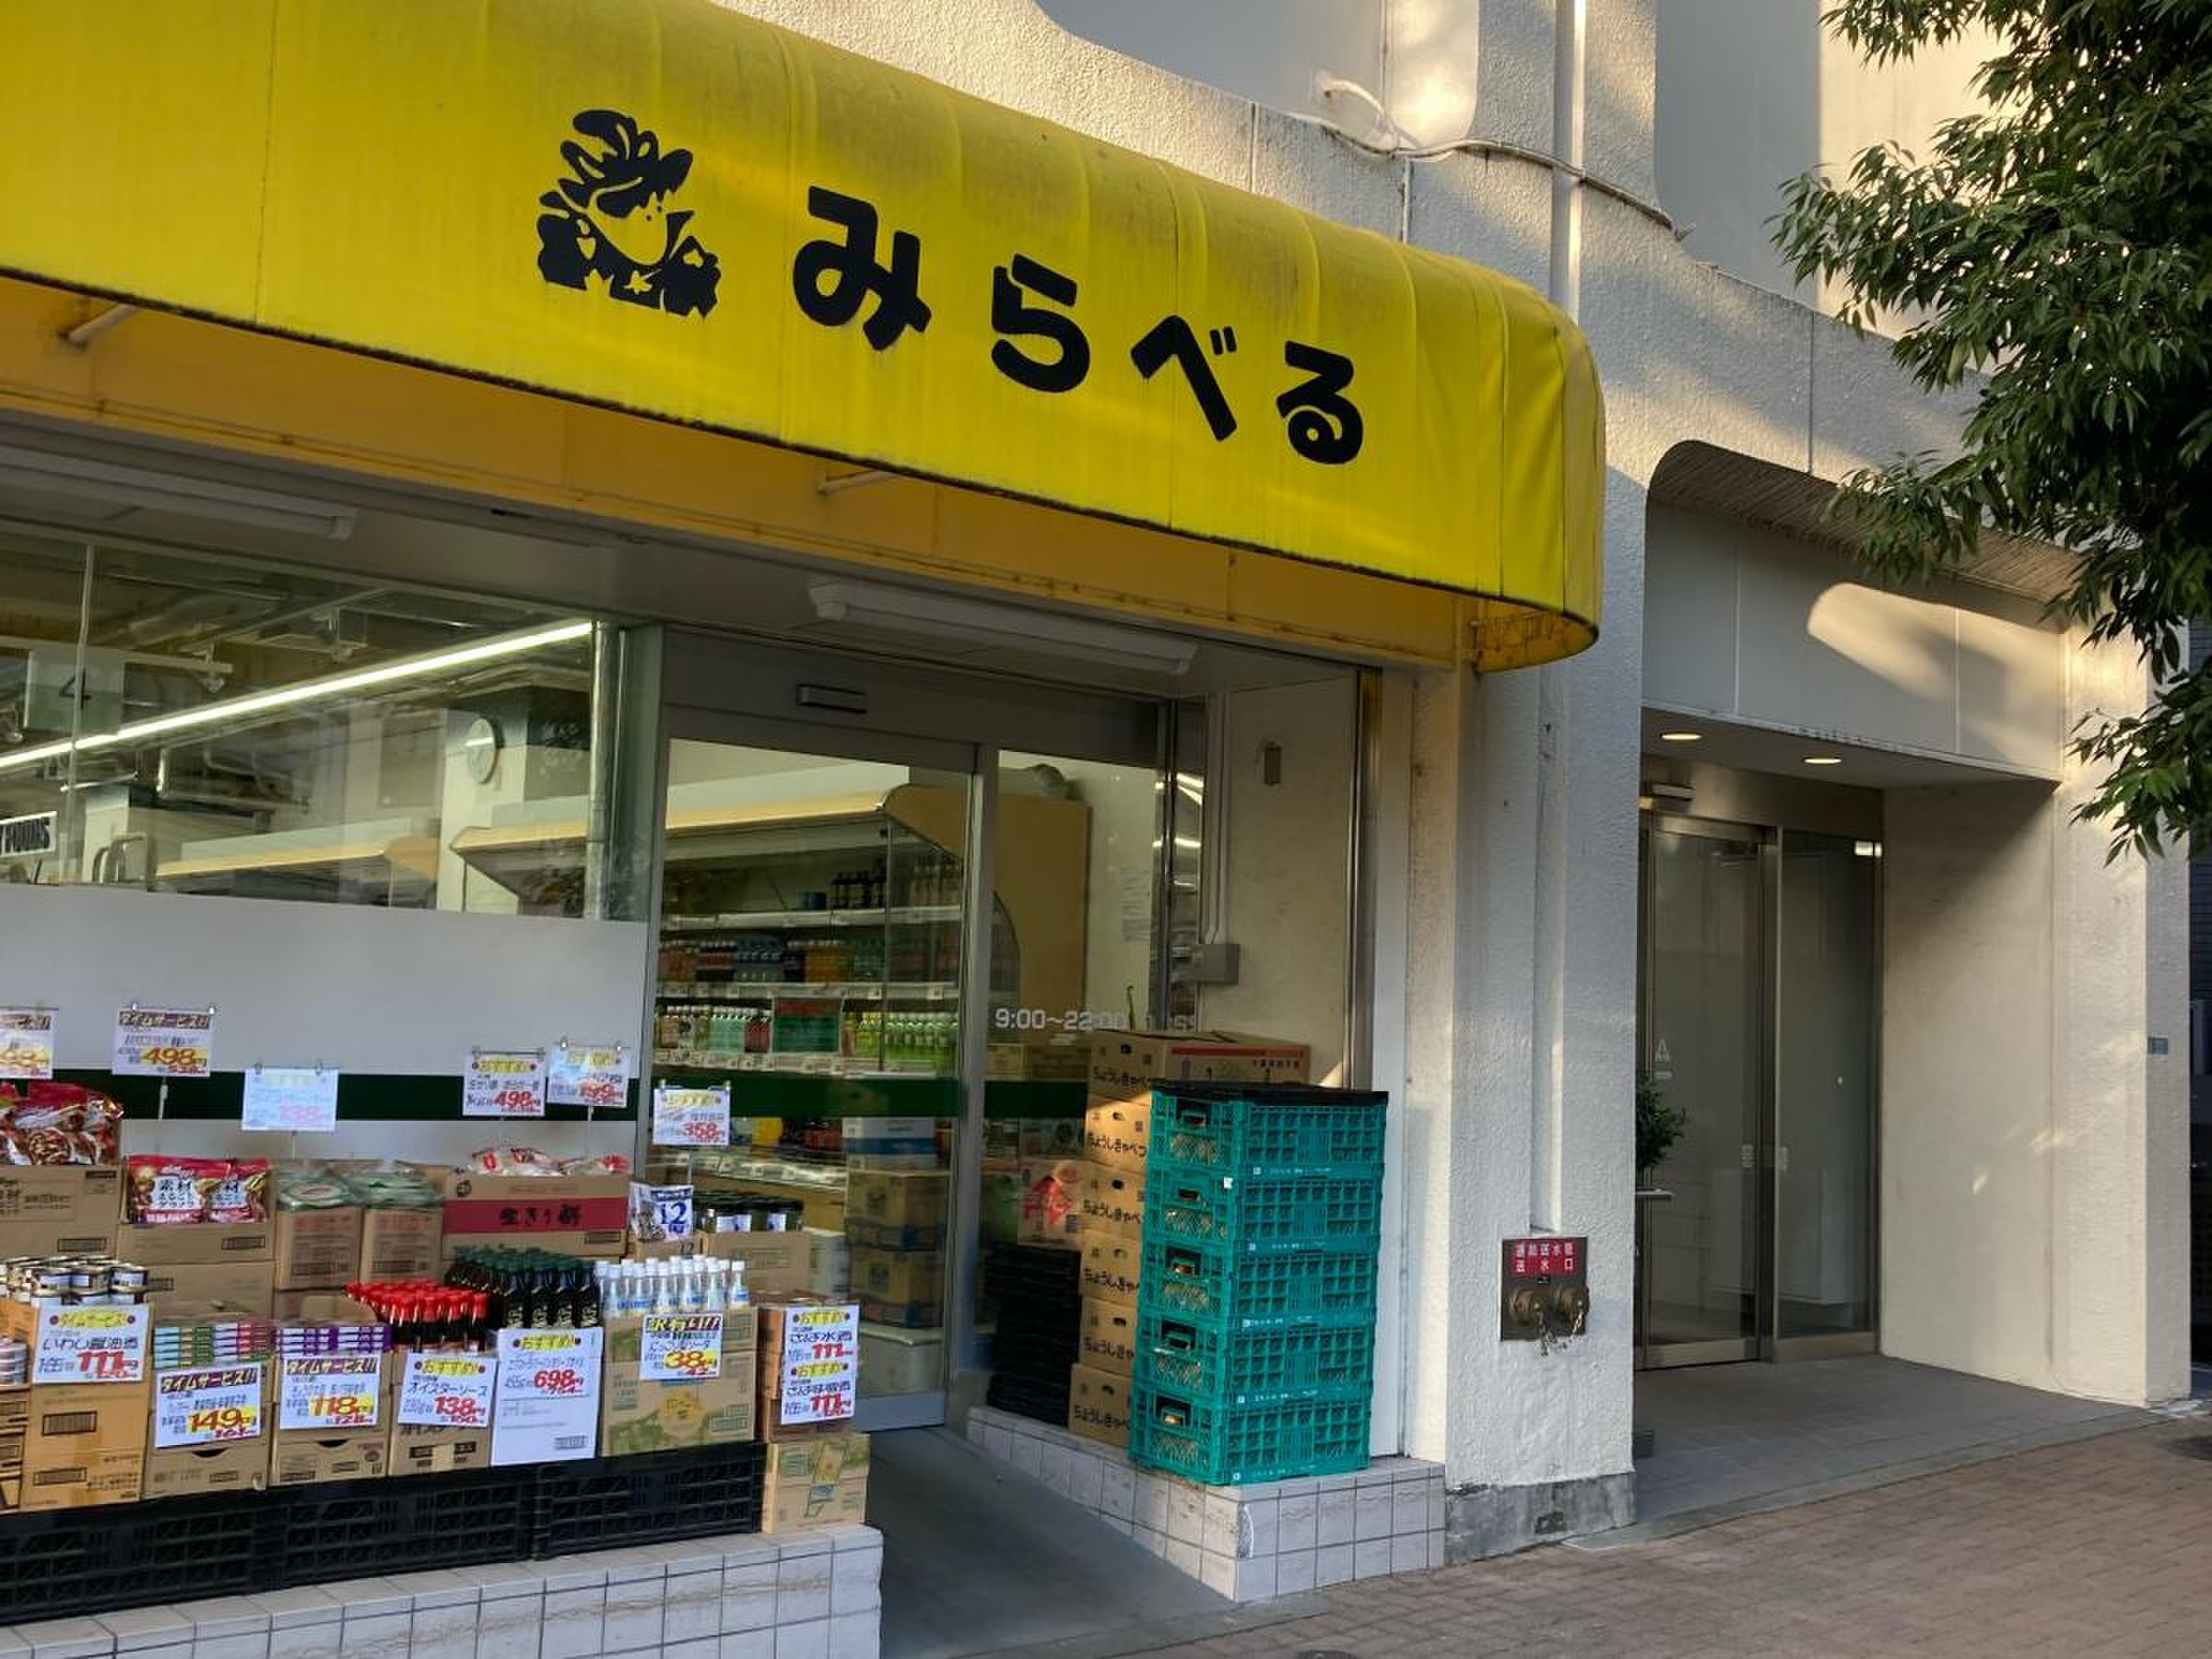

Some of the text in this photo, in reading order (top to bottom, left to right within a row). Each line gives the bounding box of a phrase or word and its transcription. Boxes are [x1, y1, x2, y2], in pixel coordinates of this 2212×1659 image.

[793, 185, 1364, 465] みらべる
[59, 669, 90, 709] 4
